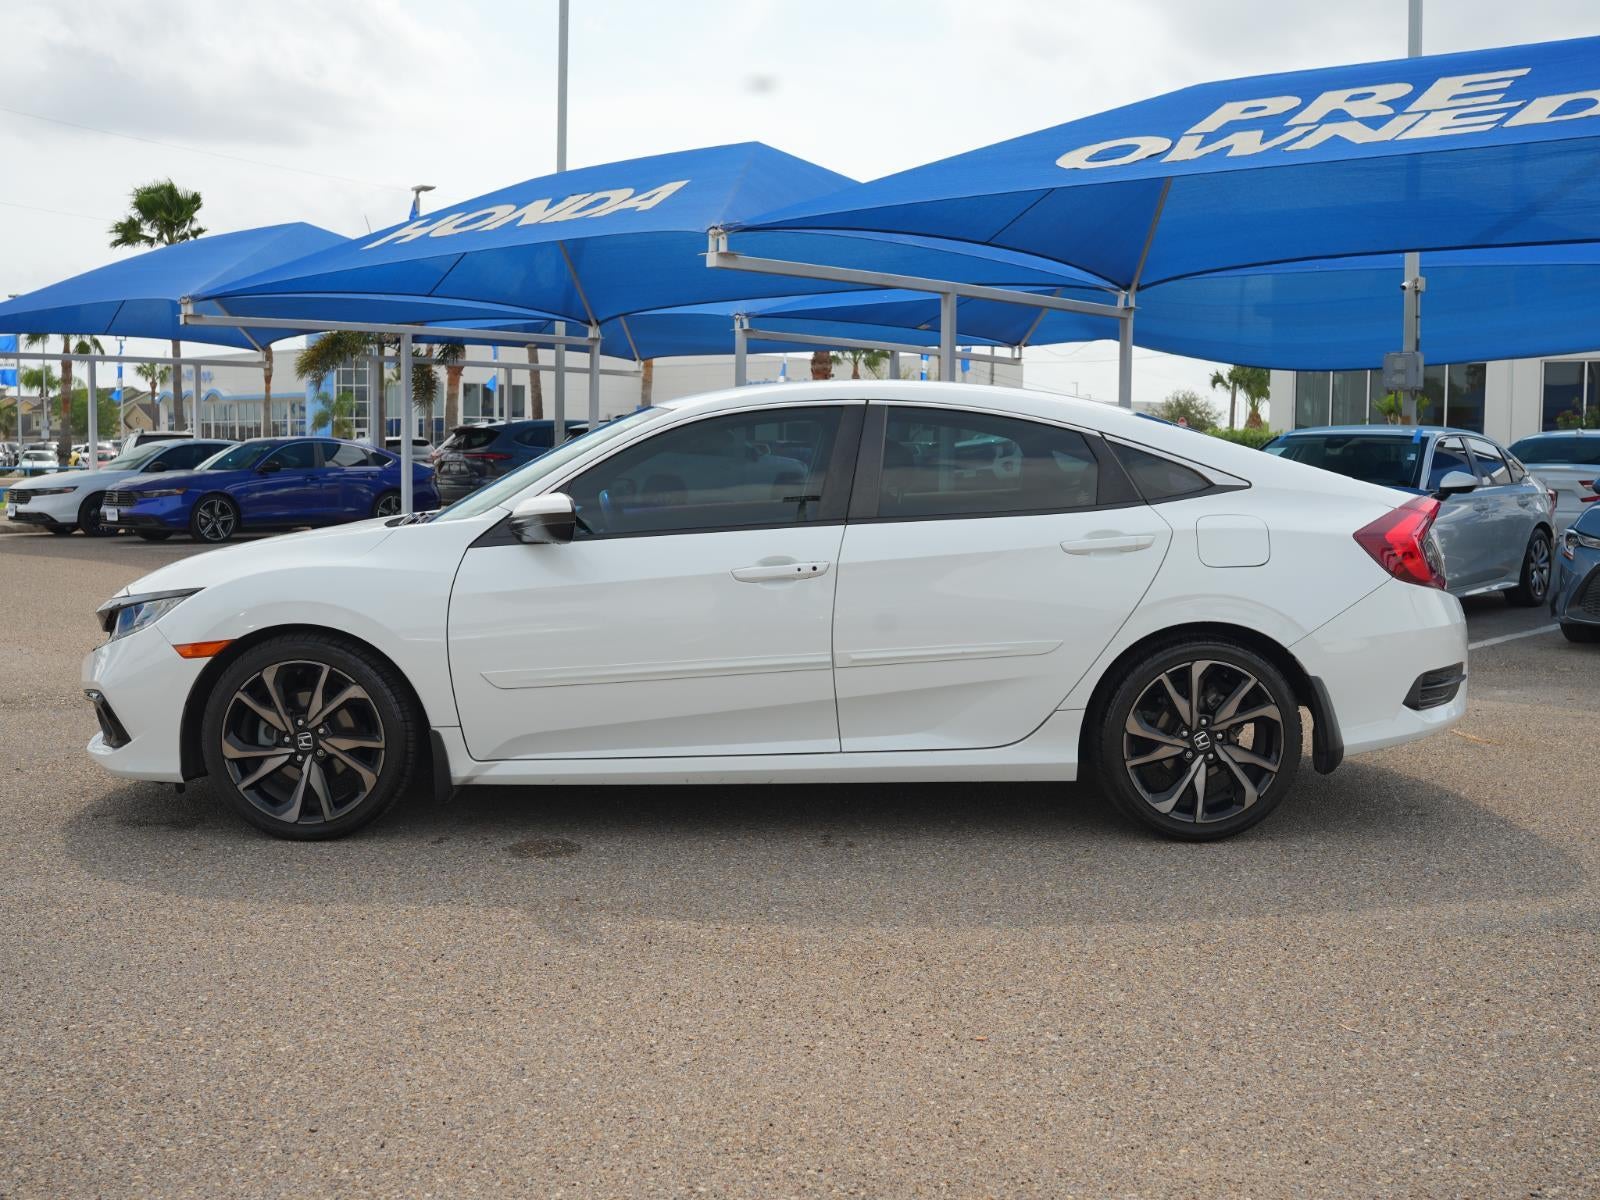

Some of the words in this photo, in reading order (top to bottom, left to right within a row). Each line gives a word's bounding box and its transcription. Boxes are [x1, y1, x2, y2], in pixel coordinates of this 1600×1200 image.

[1055, 89, 1600, 170] OWNED
[1184, 67, 1531, 135] PRE
[360, 179, 692, 250] HONDA
